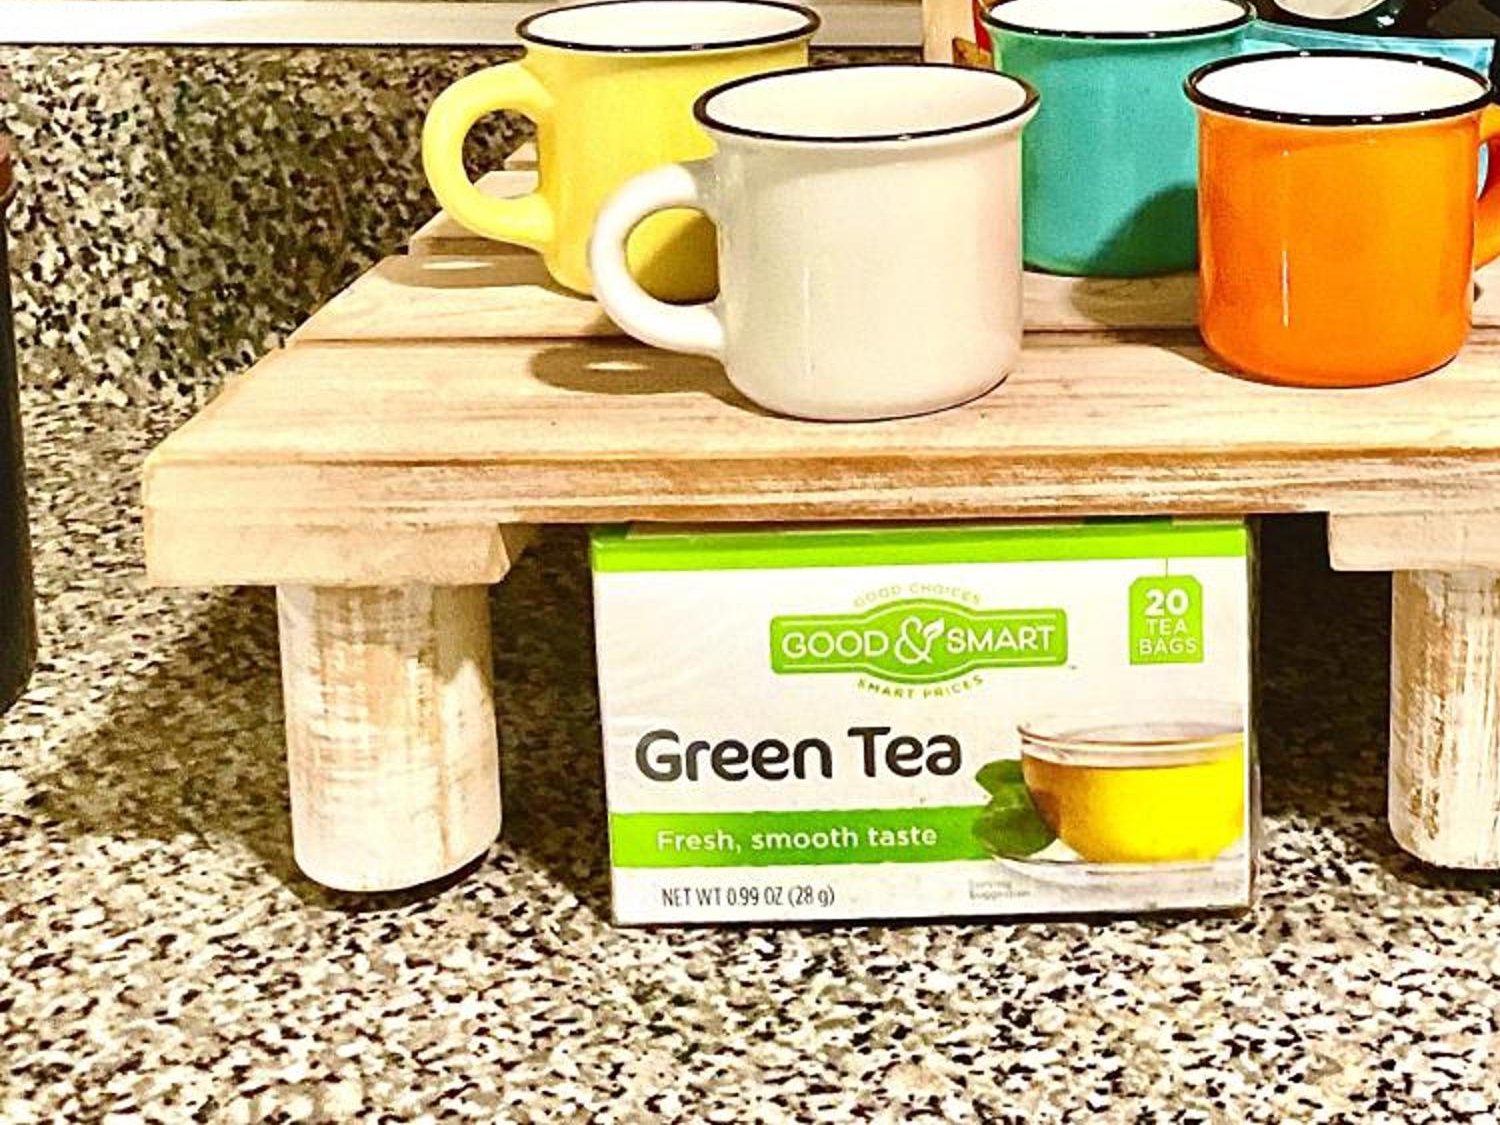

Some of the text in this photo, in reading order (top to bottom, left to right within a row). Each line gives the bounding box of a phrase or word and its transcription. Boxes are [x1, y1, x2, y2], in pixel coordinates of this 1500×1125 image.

[854, 582, 982, 608] GOOD CHOICES
[1144, 588, 1190, 616] 20
[782, 615, 1056, 665] GOOD & SMART
[1146, 619, 1188, 635] TEA
[1139, 637, 1198, 655] BAGS
[858, 676, 983, 700] SMART PRICES
[635, 726, 963, 783] Green Tea
[656, 826, 938, 854] Fresh, smooth taste
[662, 884, 835, 908] NET WT 0.99 OZ (28 g)
